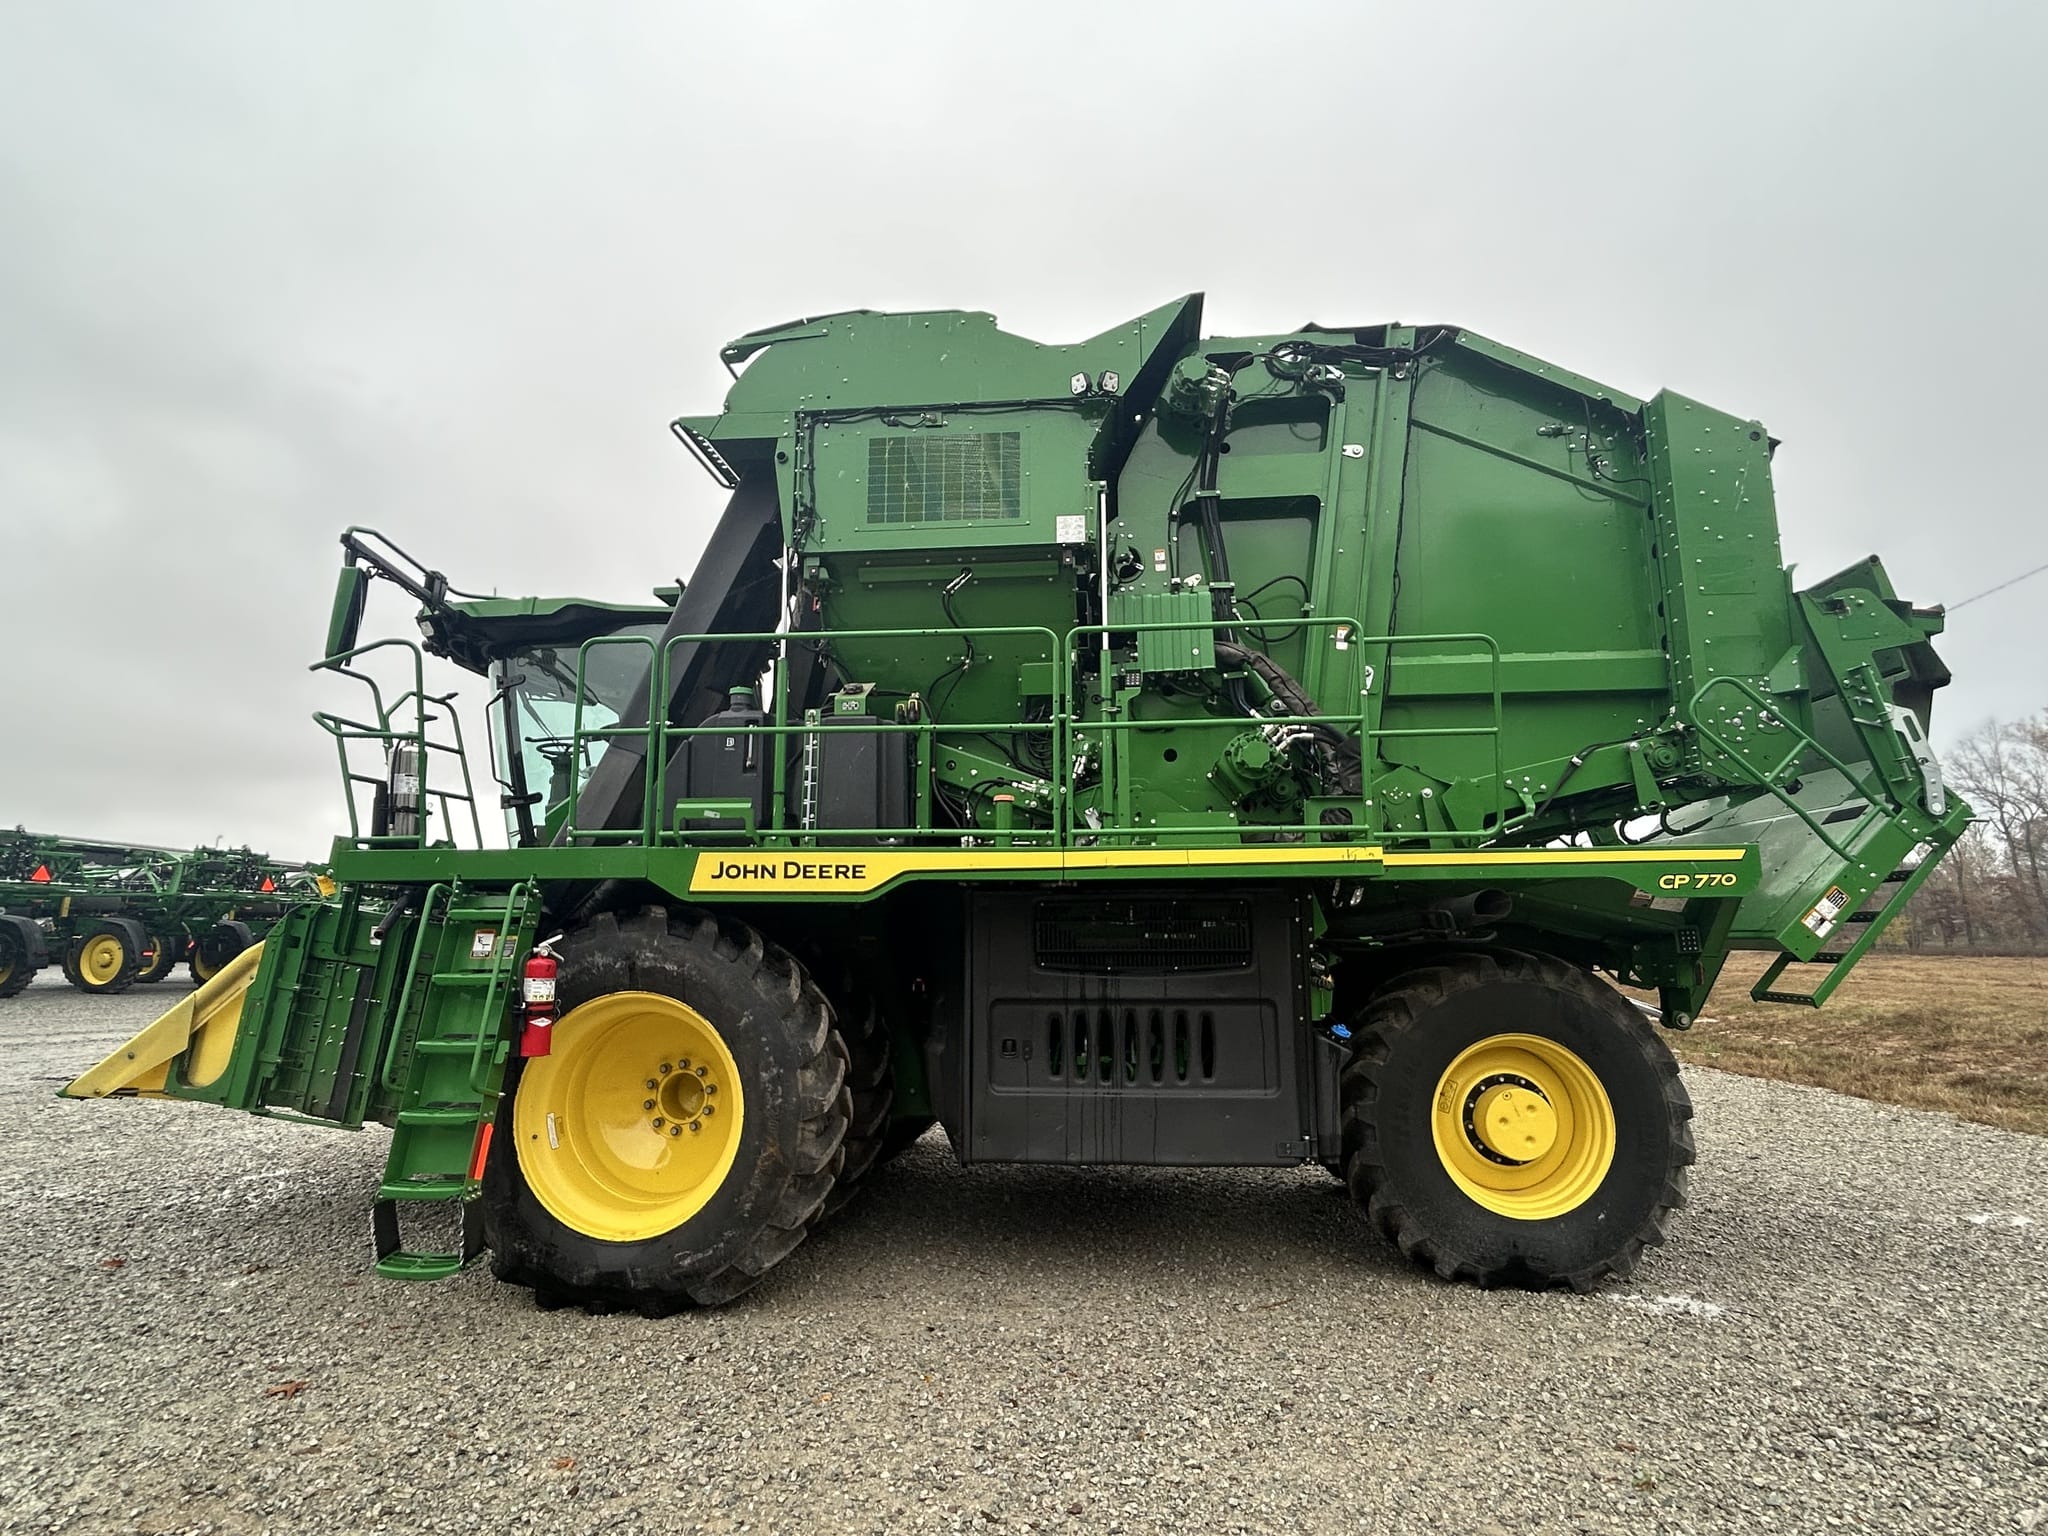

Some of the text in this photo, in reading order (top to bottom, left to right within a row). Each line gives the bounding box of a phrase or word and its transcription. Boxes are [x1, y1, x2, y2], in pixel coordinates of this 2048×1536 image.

[711, 861, 866, 879] JOHN DEERE
[1658, 872, 1738, 890] CP 770
